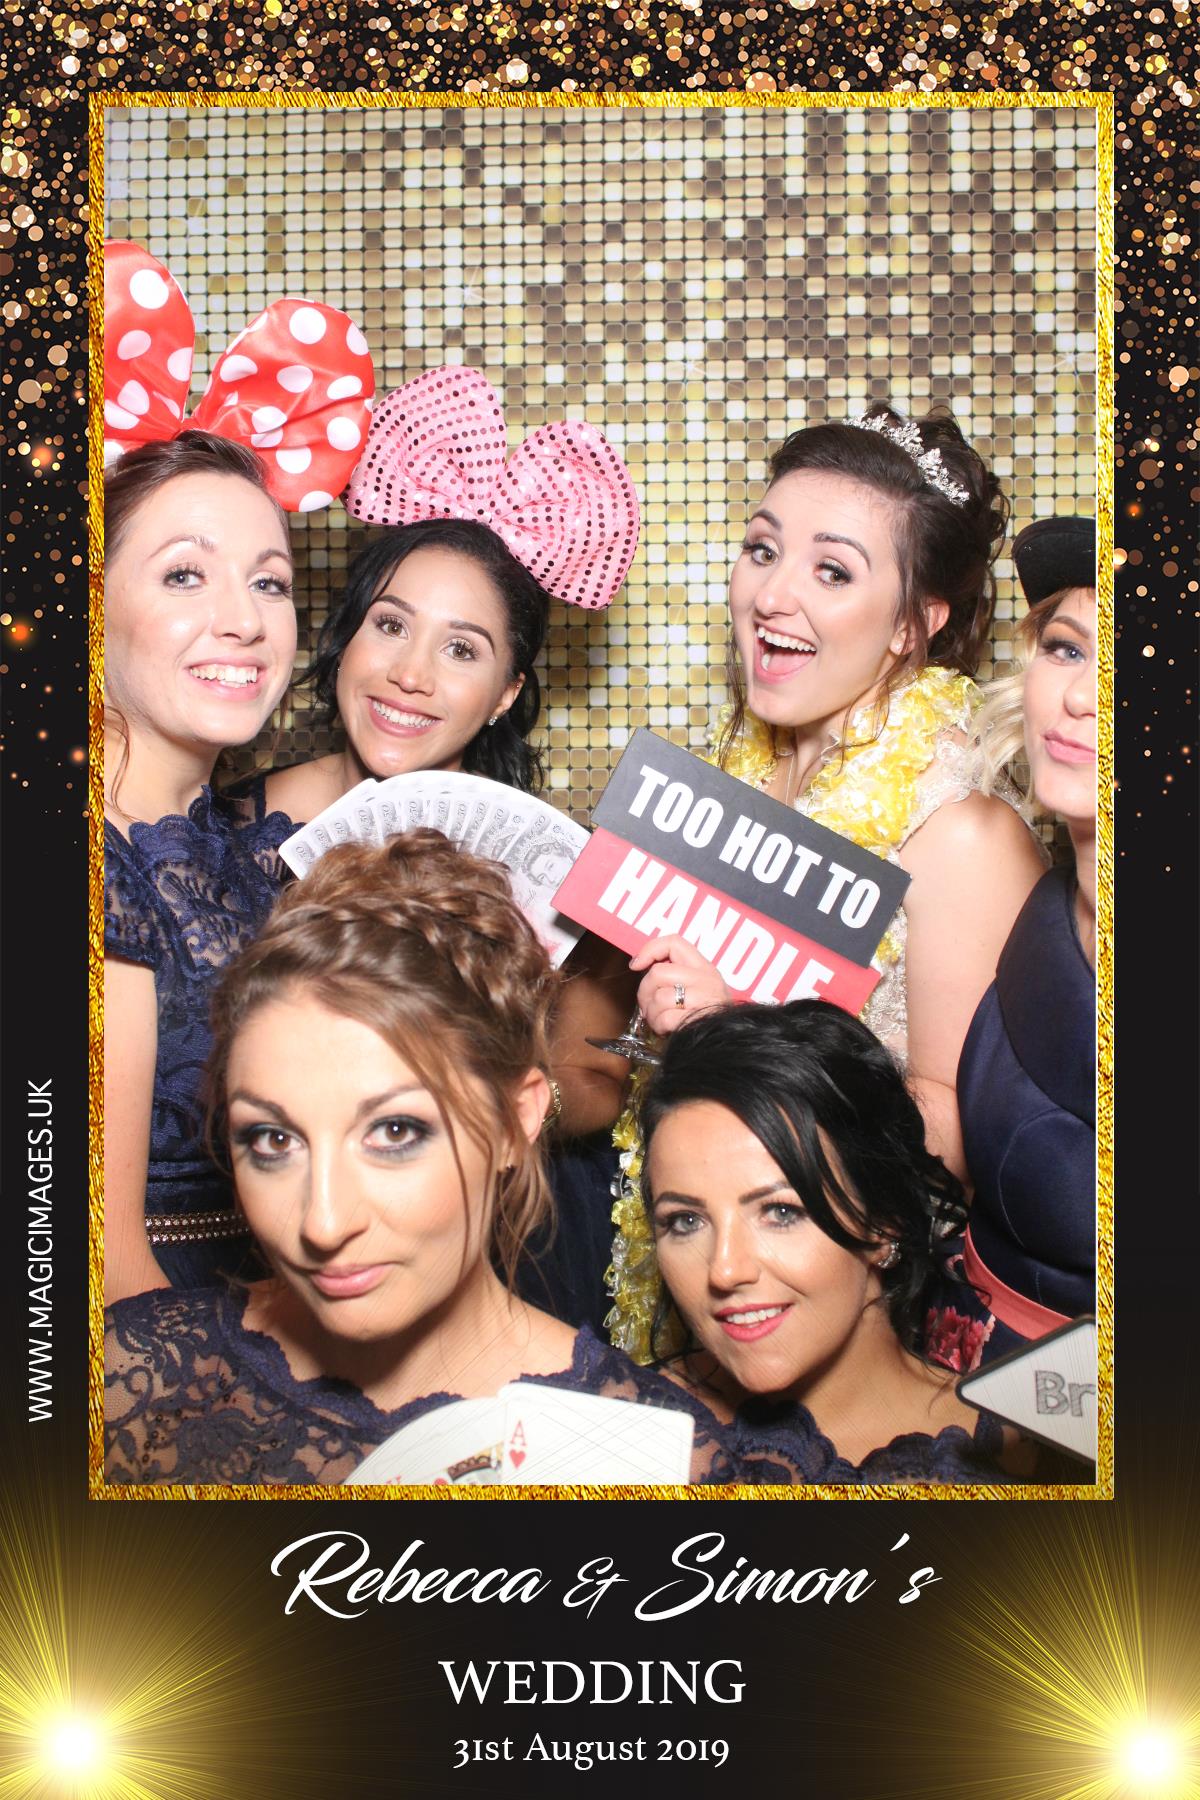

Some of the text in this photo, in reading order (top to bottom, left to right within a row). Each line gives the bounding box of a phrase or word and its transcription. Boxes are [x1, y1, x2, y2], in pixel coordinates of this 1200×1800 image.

[628, 765, 881, 929] TOO HOT TO
[597, 848, 835, 1006] HANDLE
[510, 1420, 527, 1447] A
[1035, 1370, 1096, 1417] Br
